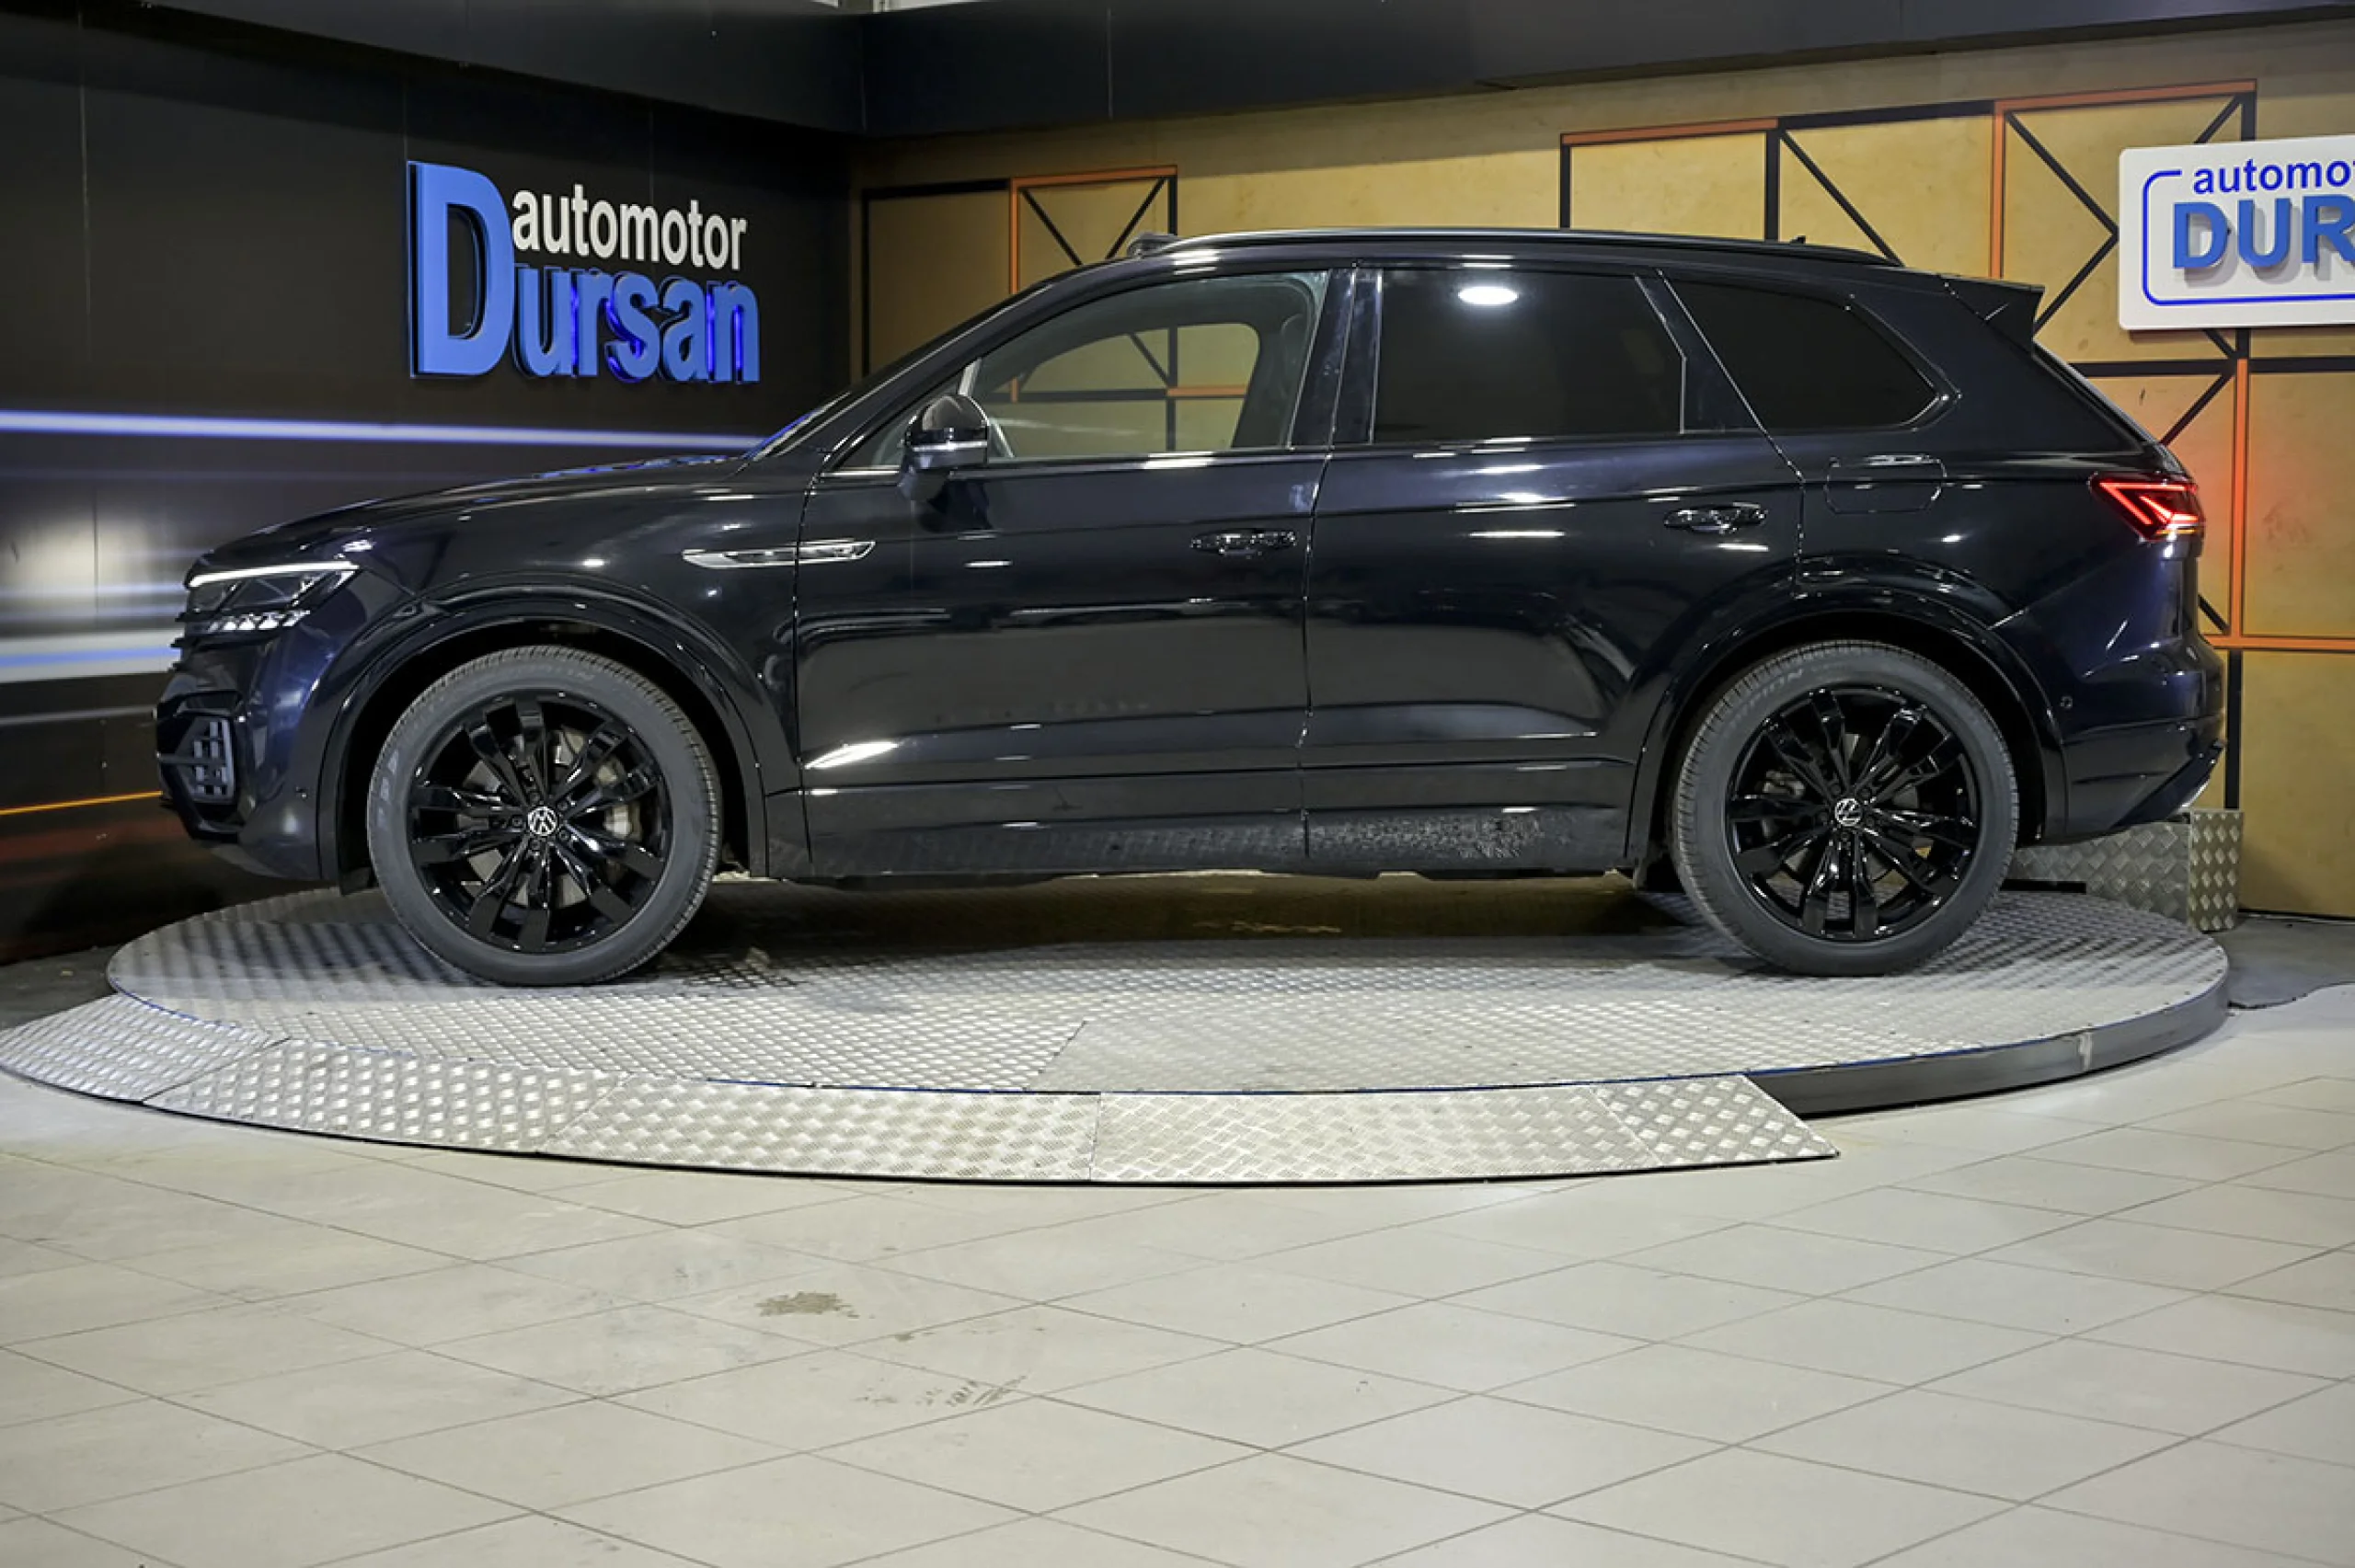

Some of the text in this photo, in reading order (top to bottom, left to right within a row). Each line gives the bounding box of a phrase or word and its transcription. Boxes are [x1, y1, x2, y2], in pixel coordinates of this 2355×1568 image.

[2193, 159, 2355, 195] automo
[512, 184, 748, 270] automotor
[2172, 194, 2355, 269] DUR
[407, 161, 761, 383] Dursan
